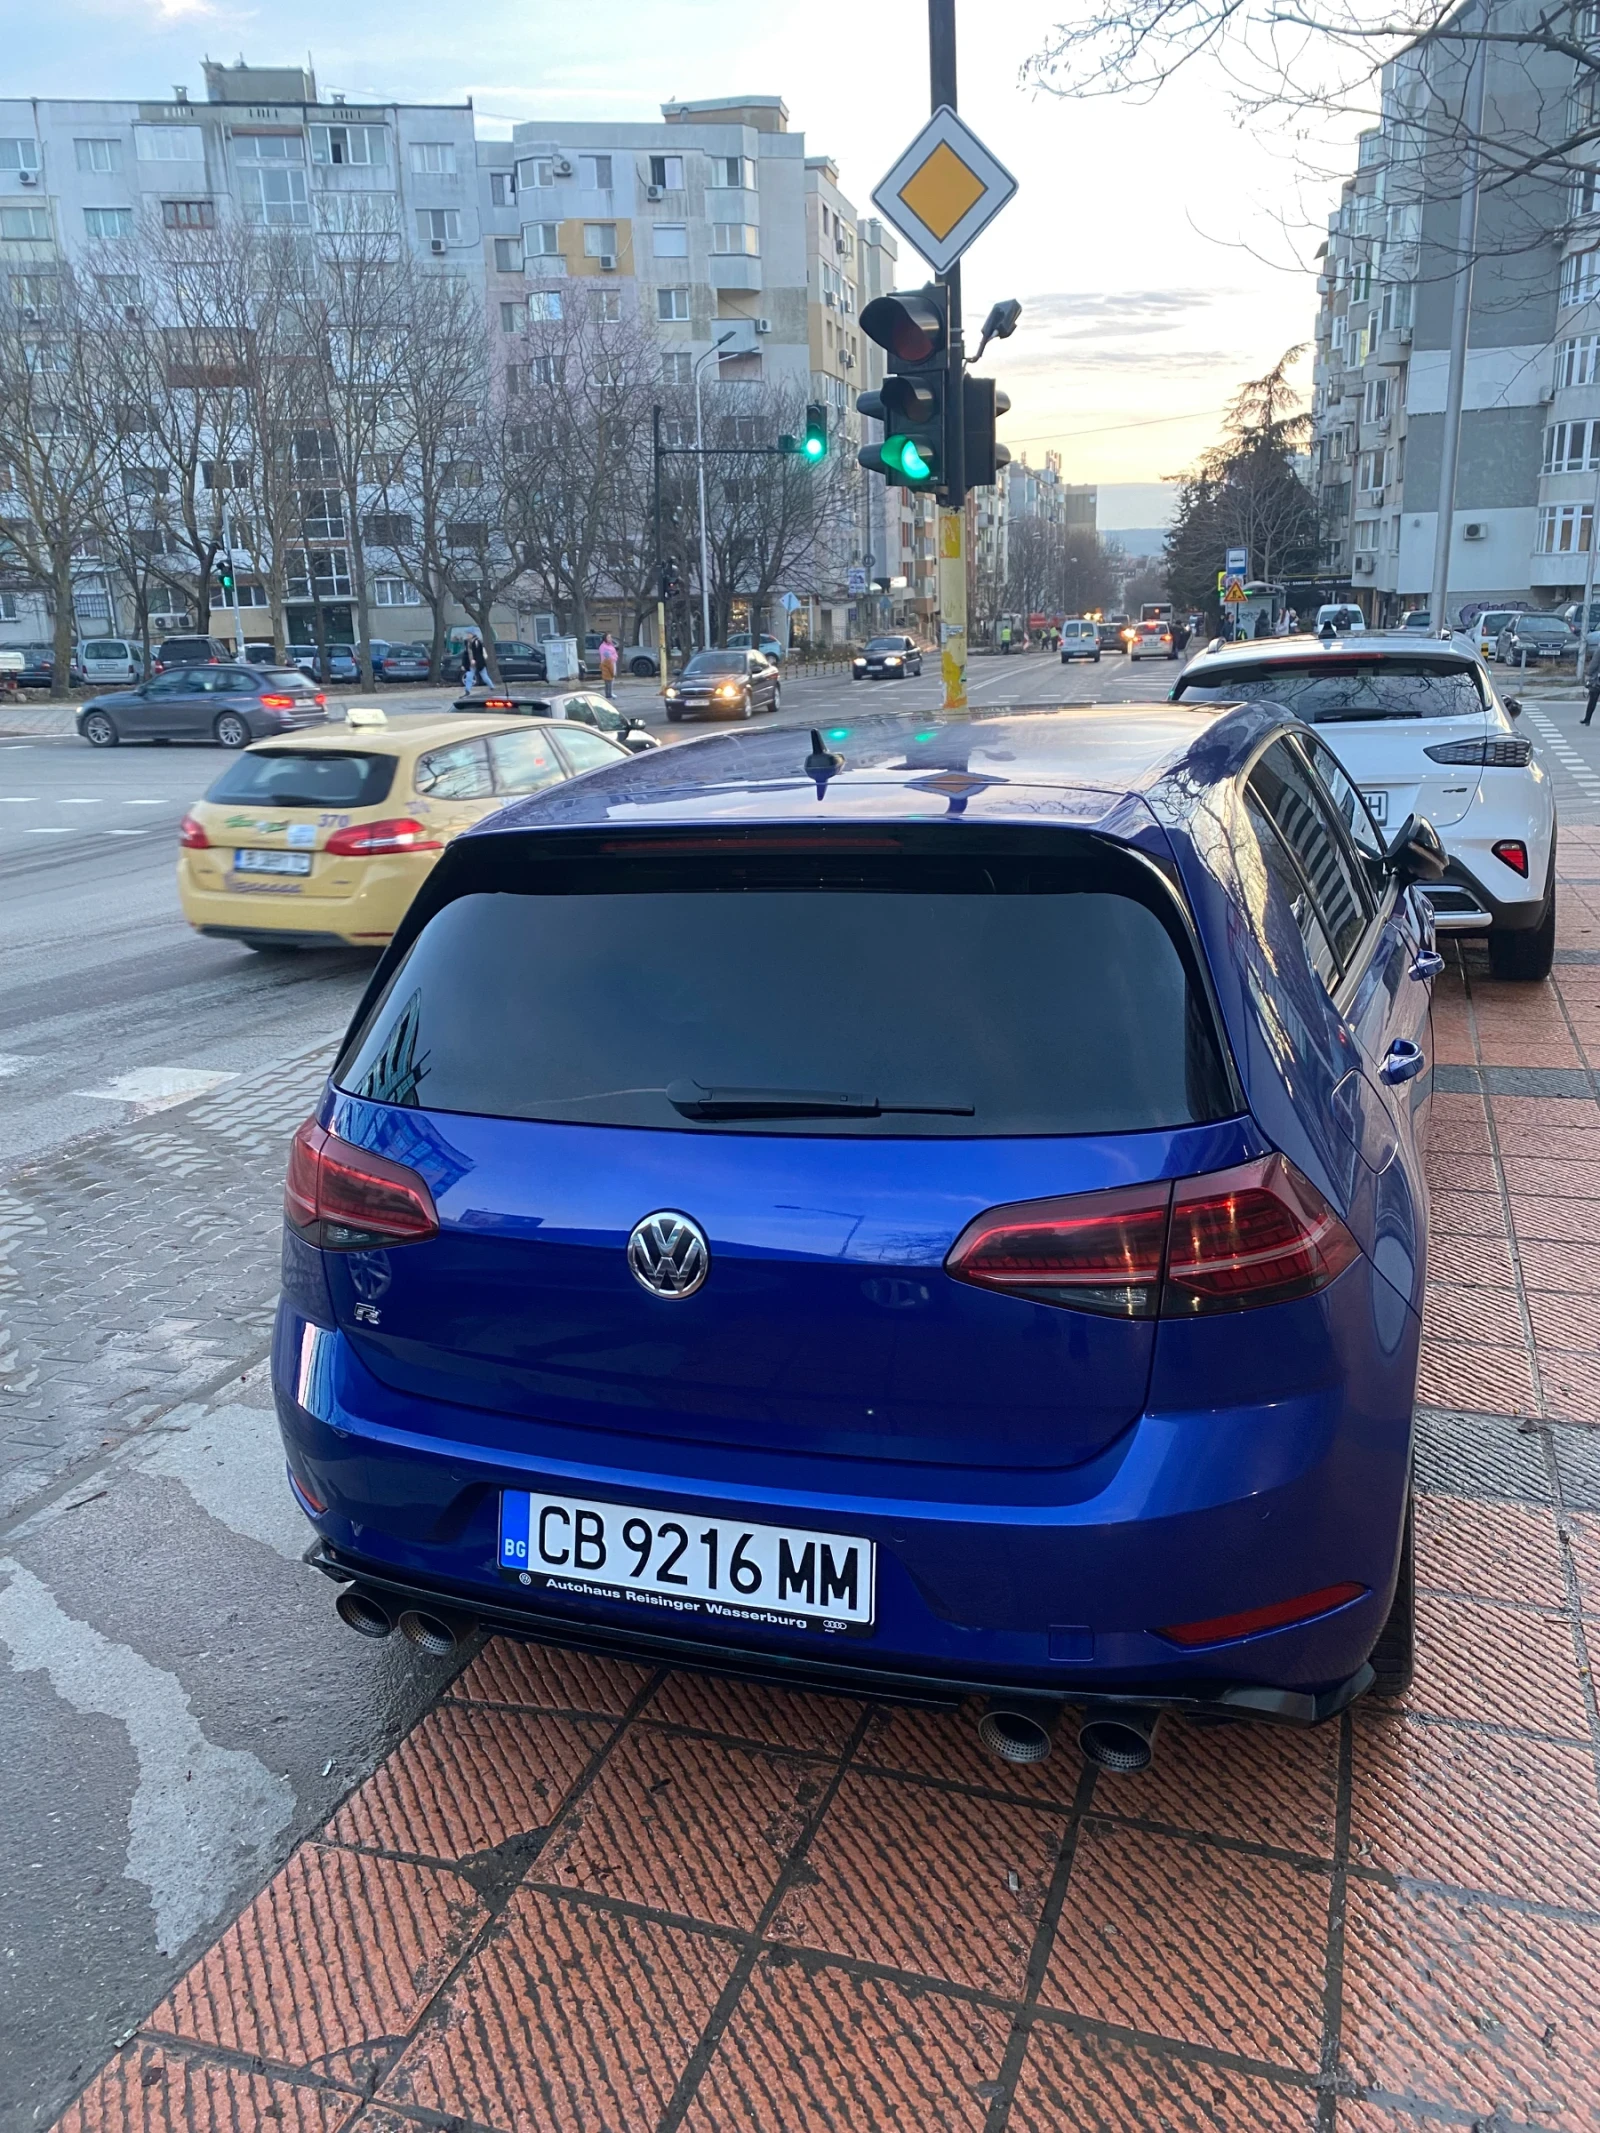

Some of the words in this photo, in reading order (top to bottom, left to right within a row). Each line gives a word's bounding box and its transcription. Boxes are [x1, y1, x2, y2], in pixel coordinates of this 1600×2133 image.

[1363, 796, 1382, 817] H
[354, 1302, 380, 1325] R
[504, 1538, 527, 1559] BG
[538, 1505, 607, 1571] CB
[622, 1517, 763, 1595] 9216
[777, 1537, 860, 1611] MM
[546, 1577, 621, 1600] Autohaus
[625, 1589, 701, 1612] Reisinger
[705, 1602, 808, 1629] Wasserburg
